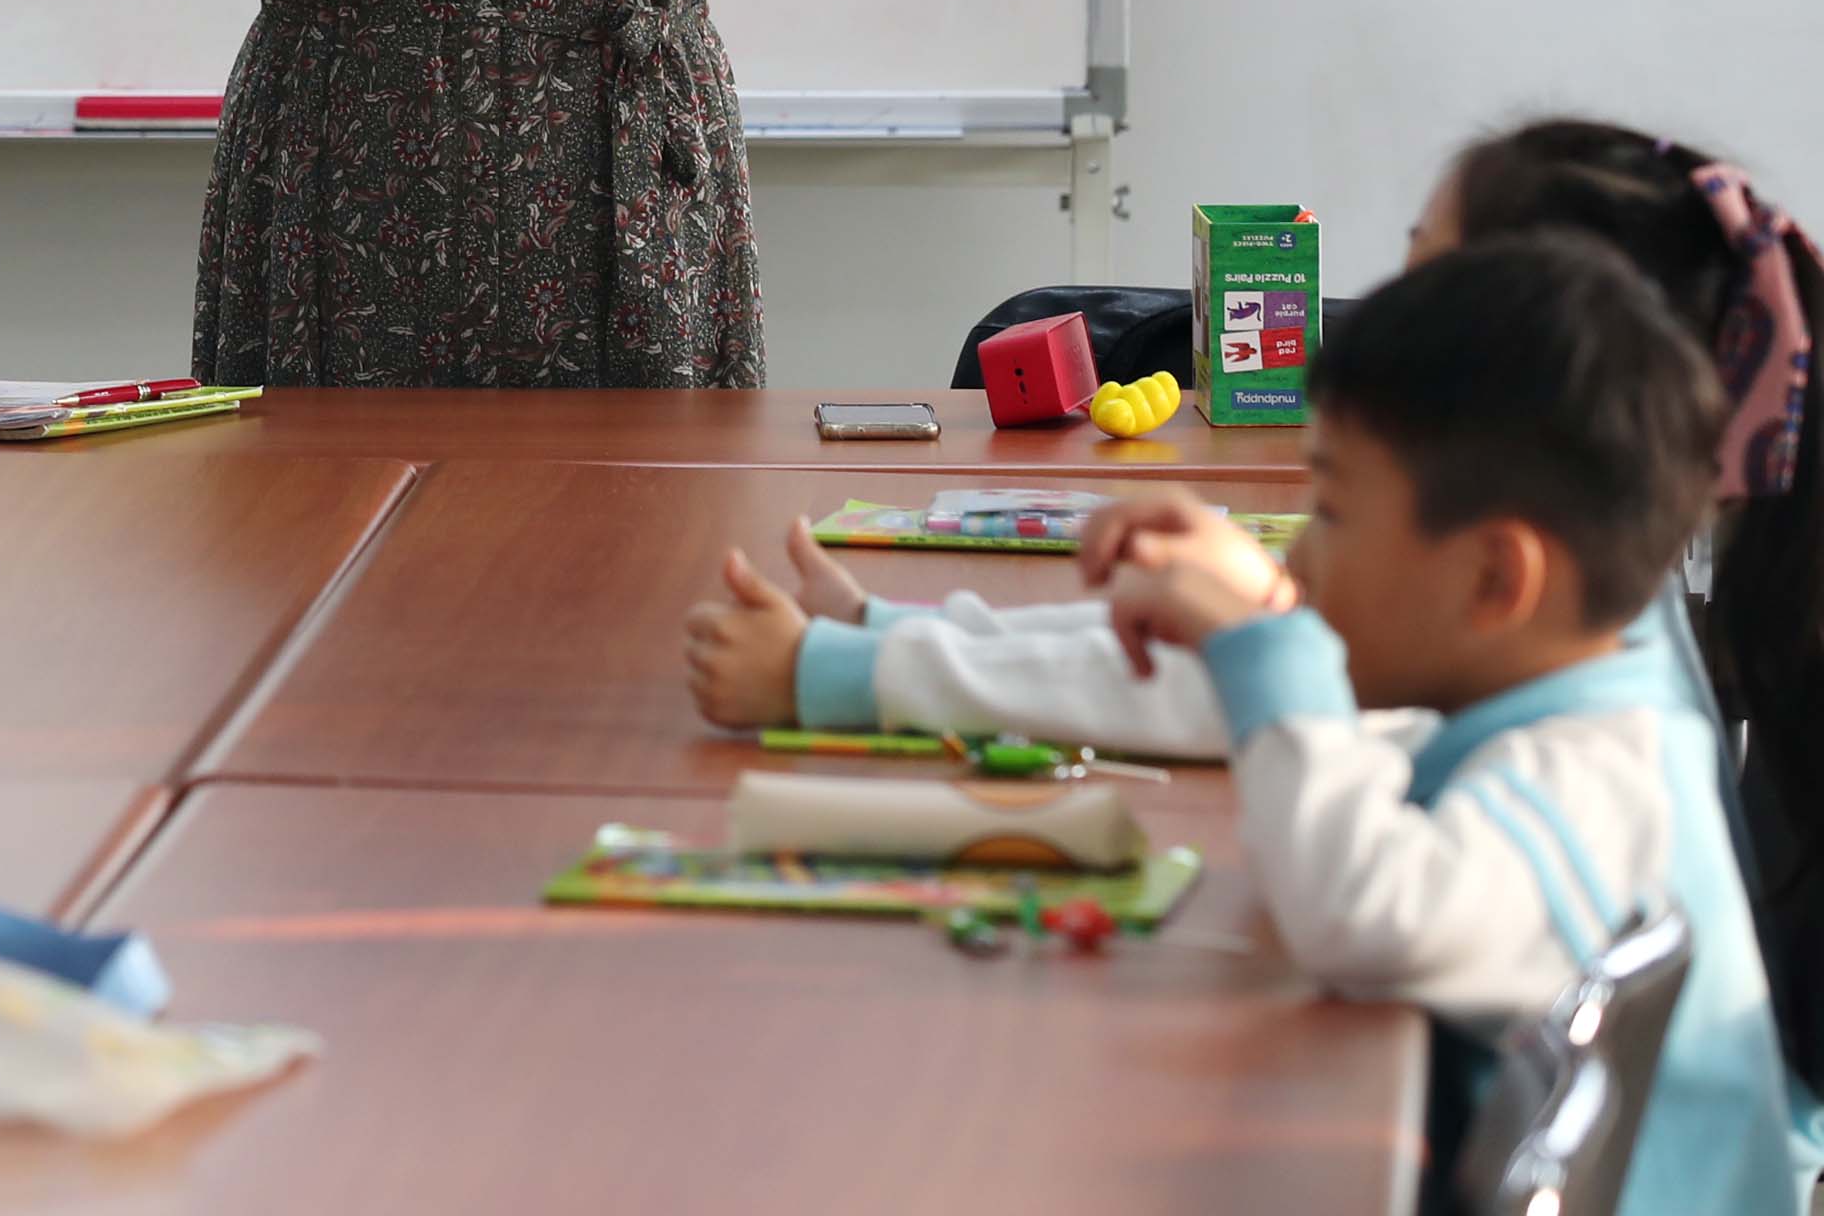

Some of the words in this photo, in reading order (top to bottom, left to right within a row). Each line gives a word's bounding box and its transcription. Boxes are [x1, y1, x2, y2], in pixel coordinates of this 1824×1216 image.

[1224, 273, 1254, 283] Pairs
[1255, 273, 1292, 283] Puzzle
[1293, 273, 1307, 283] 10
[1281, 303, 1298, 311] cat
[1275, 310, 1305, 318] purple
[1276, 339, 1296, 348] bird
[1278, 347, 1296, 355] red
[1236, 392, 1296, 405] mudpuppy
